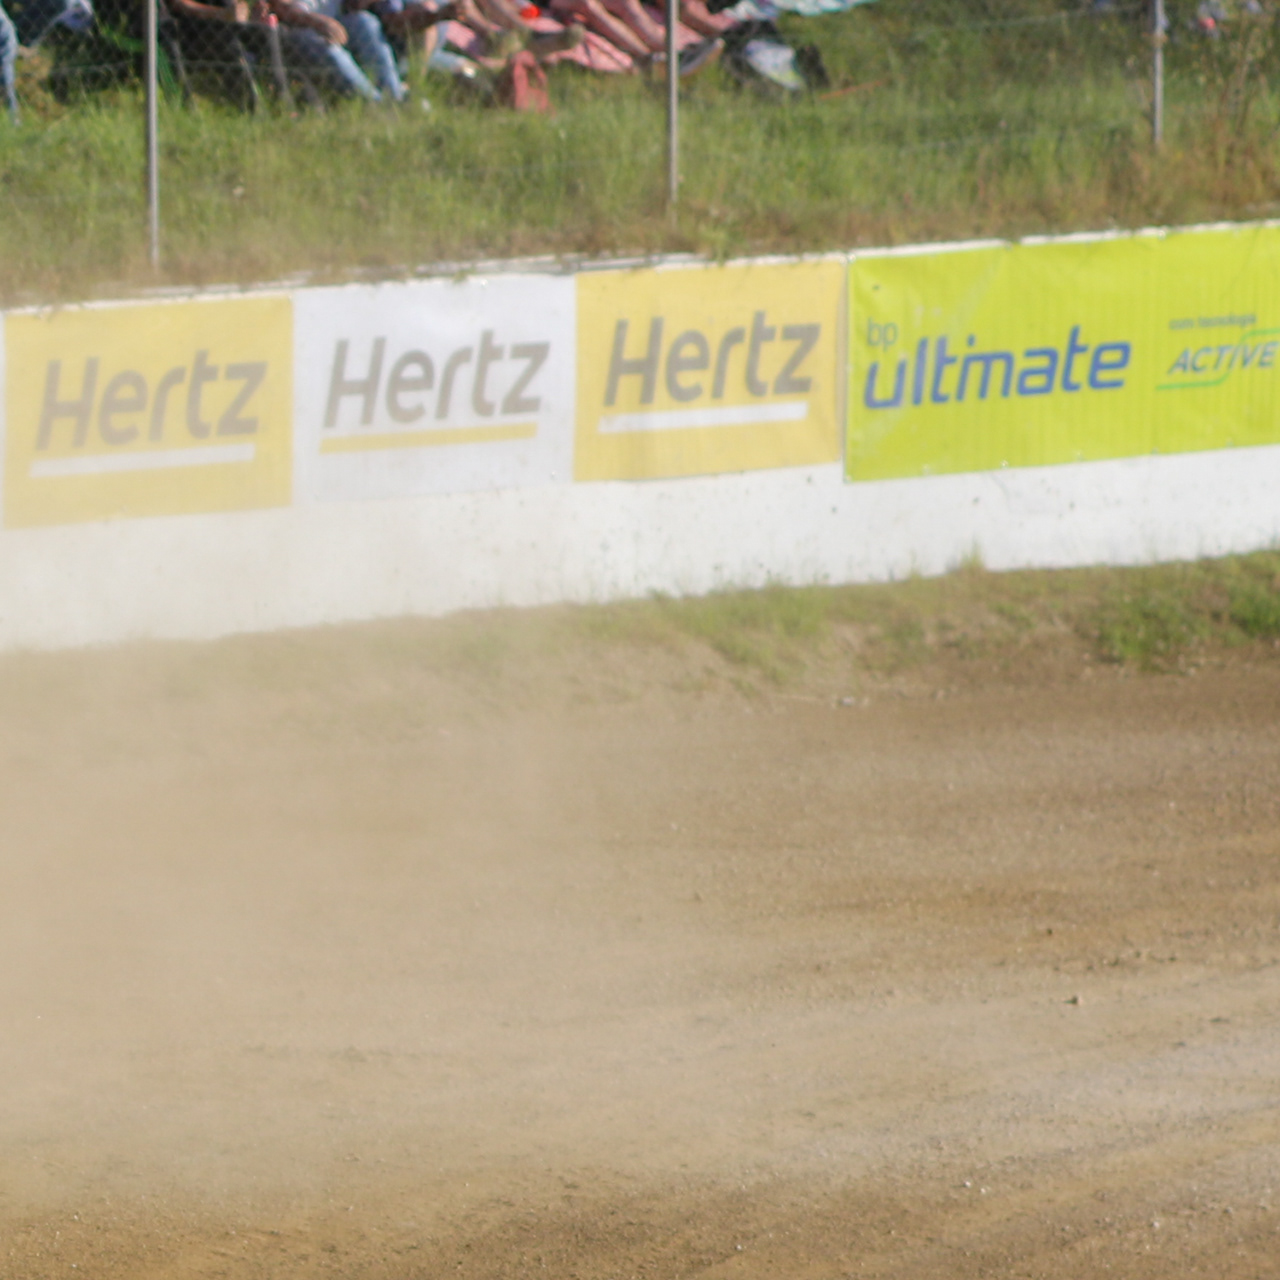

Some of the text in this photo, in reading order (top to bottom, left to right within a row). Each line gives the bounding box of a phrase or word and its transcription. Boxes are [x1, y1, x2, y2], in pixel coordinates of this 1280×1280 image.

[323, 327, 551, 429] Hertz
[603, 310, 822, 408] Hertz
[863, 325, 1131, 409] ultimate
[867, 317, 898, 352] bp
[1166, 341, 1280, 376] ACTIVE
[34, 349, 267, 451] Hertz
